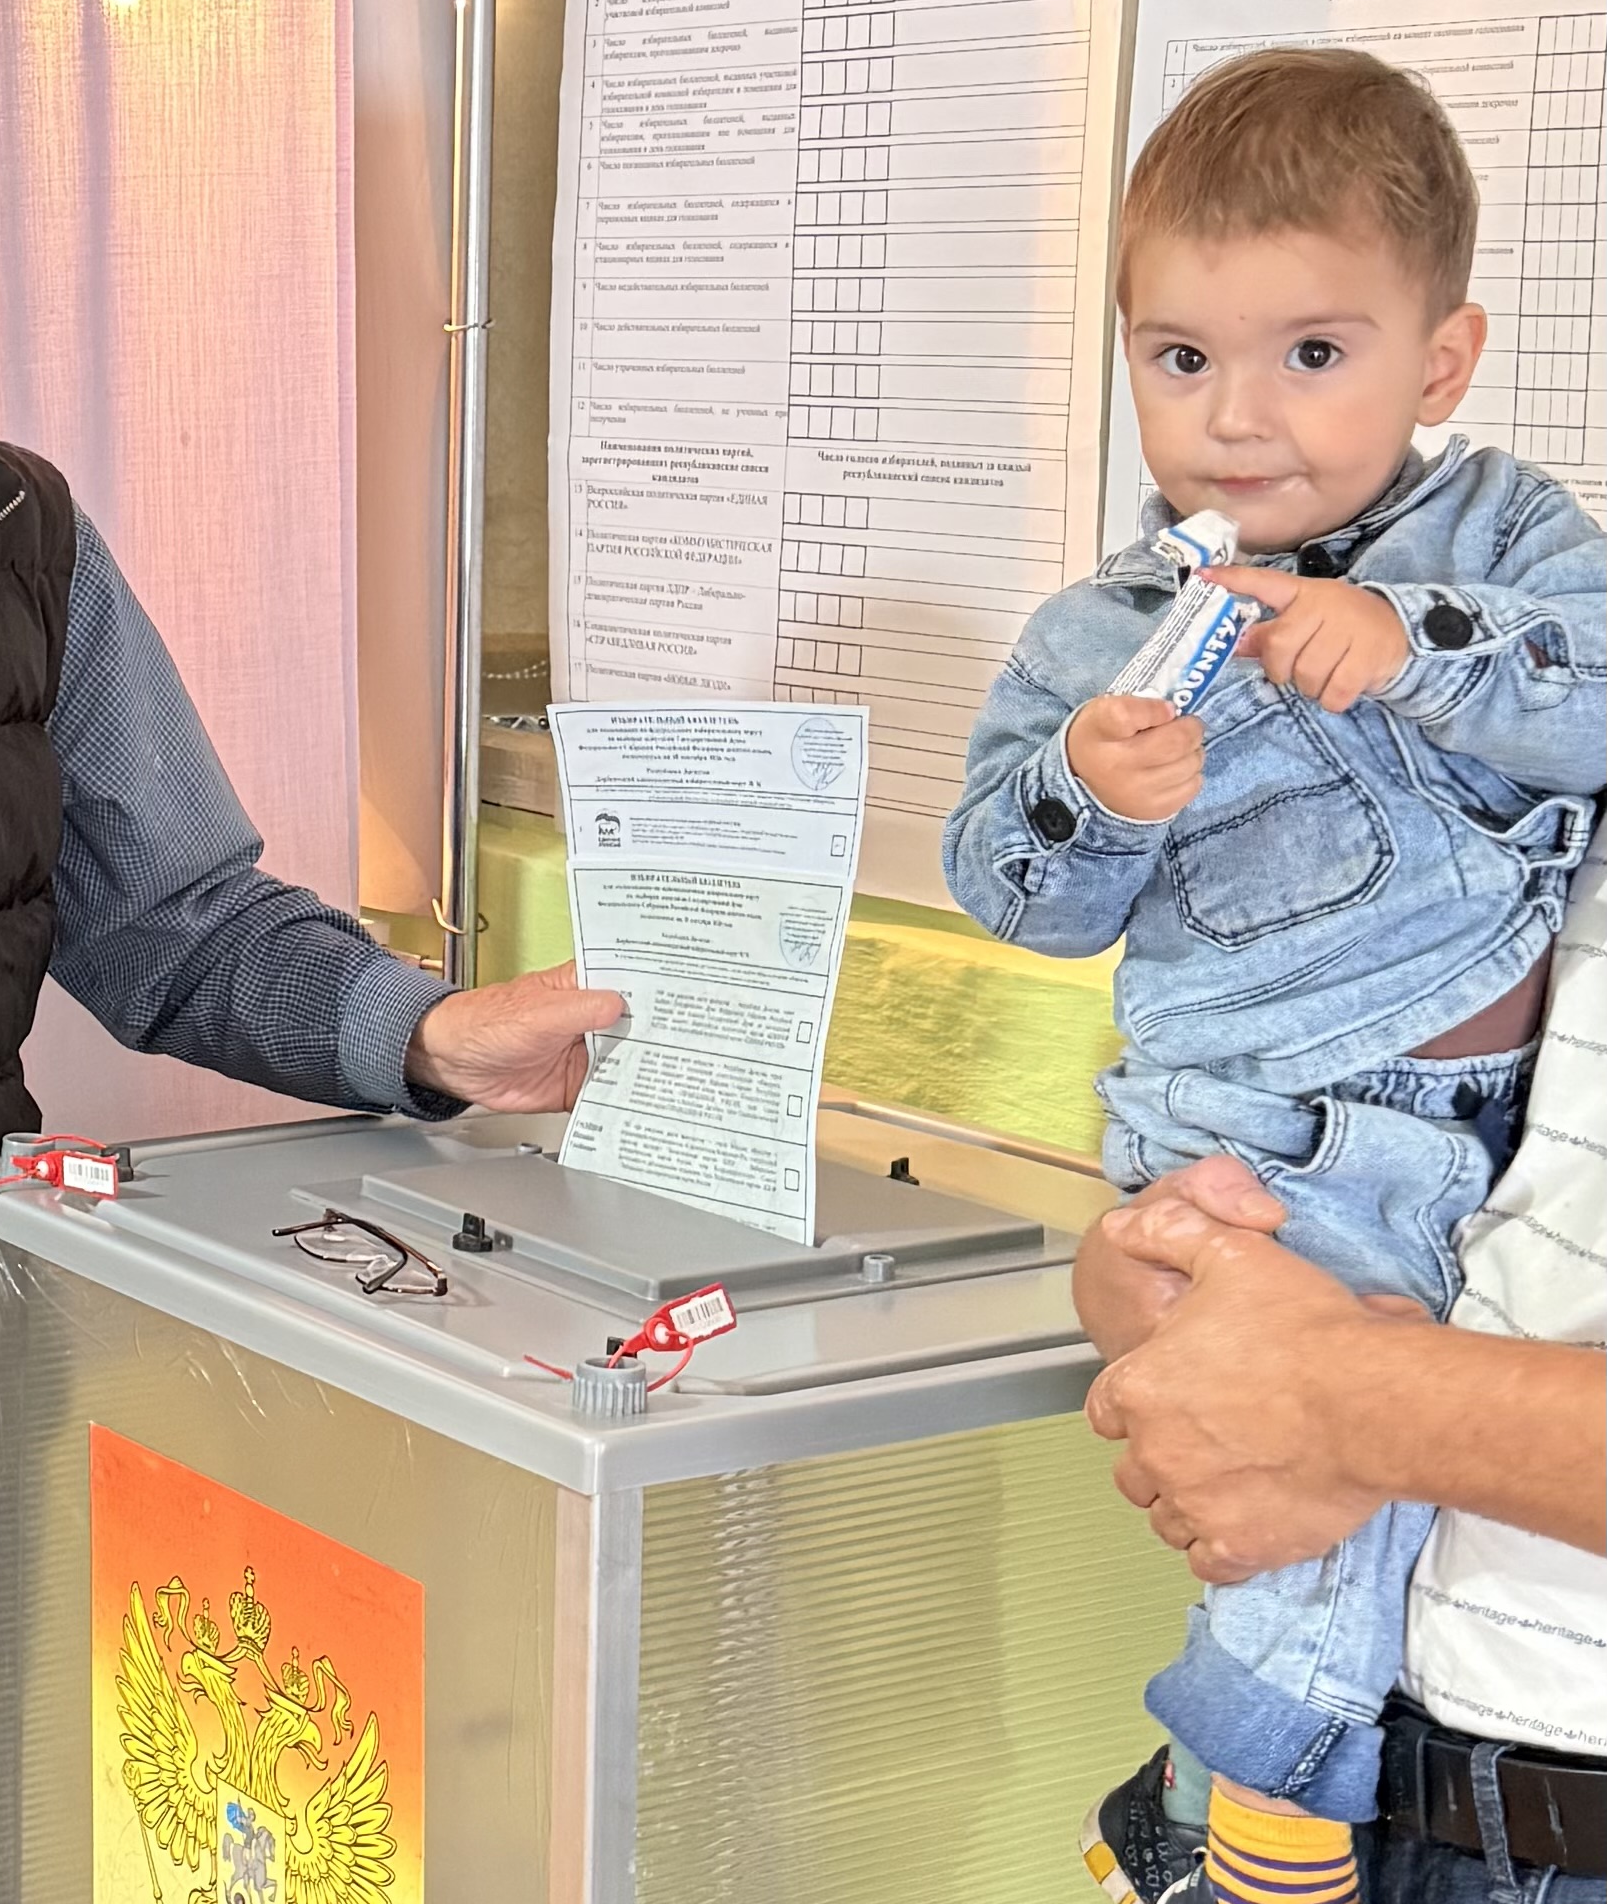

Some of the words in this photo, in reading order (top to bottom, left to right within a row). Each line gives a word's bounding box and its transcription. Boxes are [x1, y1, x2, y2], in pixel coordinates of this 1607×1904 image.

[1173, 614, 1237, 716] OUNTY
[1461, 1597, 1518, 1626] heritage
[1532, 1618, 1593, 1646] heritage
[1508, 1710, 1563, 1737] heritage
